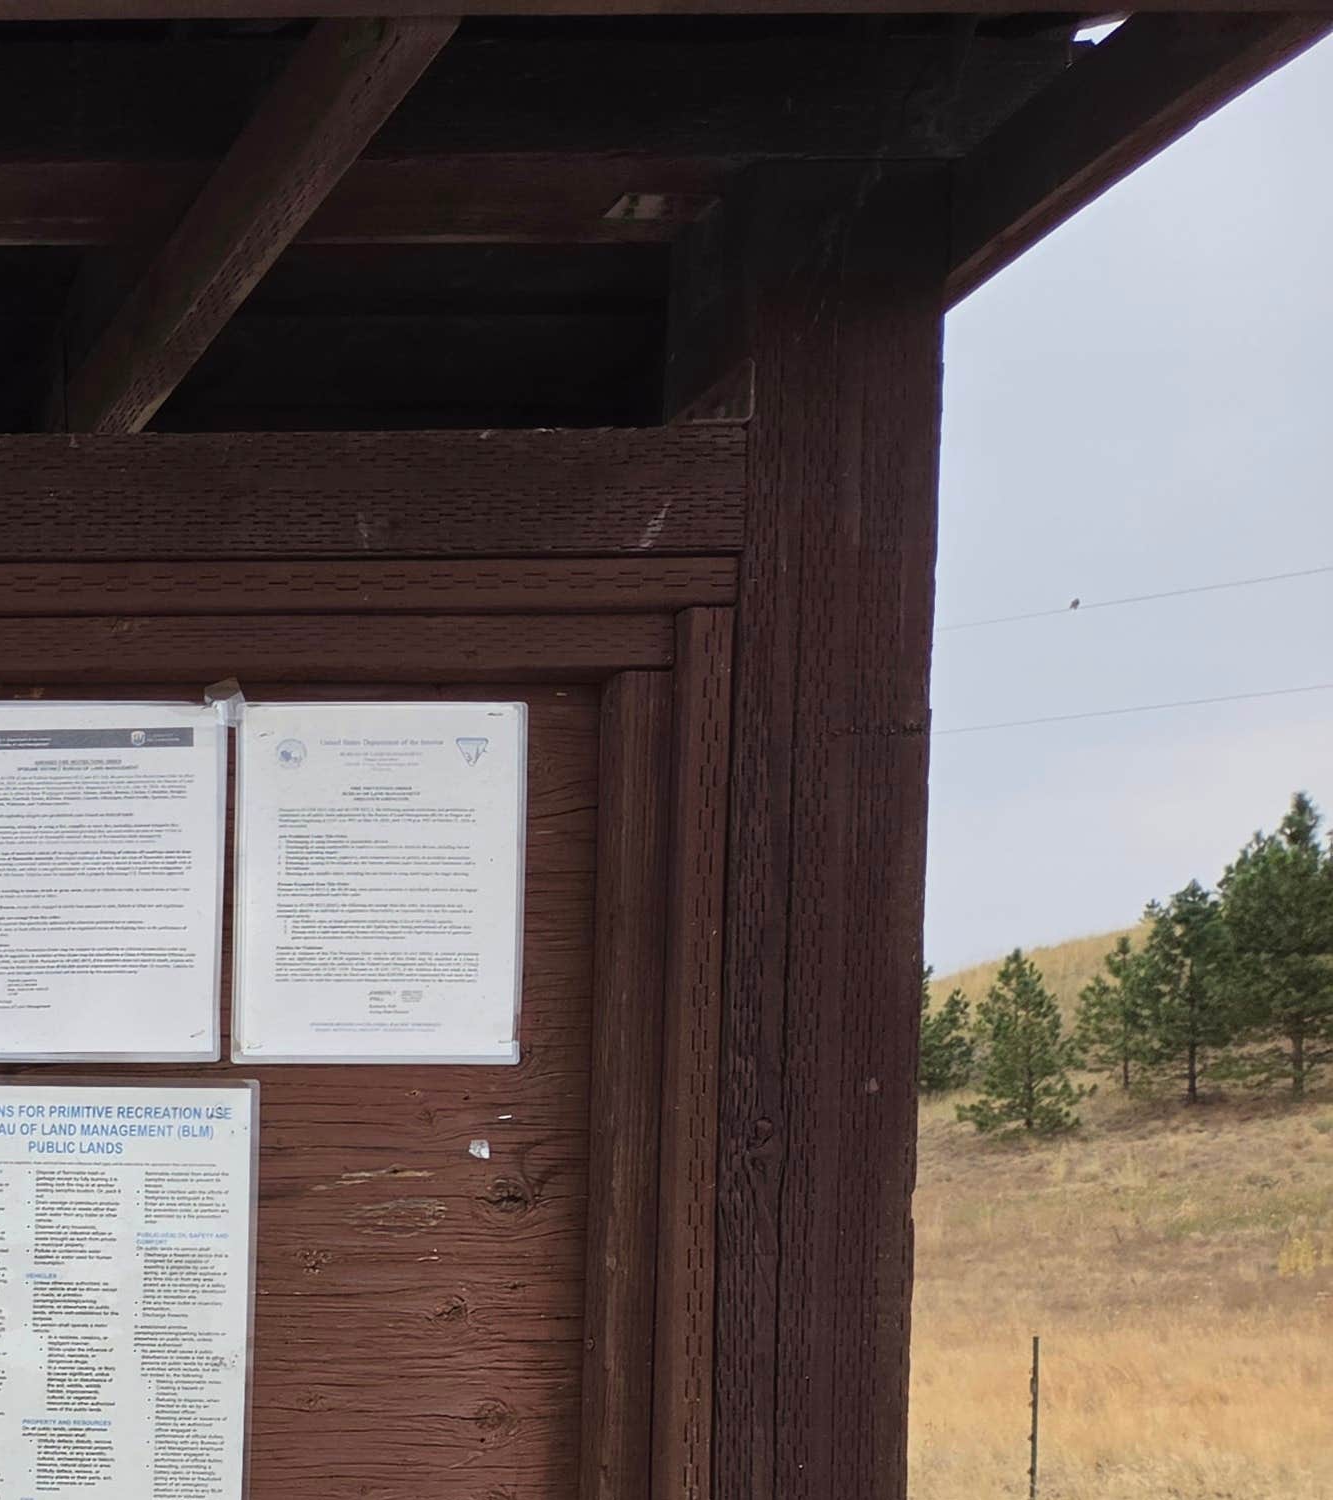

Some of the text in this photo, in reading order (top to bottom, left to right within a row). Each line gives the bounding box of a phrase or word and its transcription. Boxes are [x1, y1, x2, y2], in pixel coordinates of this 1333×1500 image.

[18, 1106, 45, 1118] FOR
[50, 1106, 112, 1118] PRIMITIVE
[117, 1107, 201, 1119] RECREATION
[205, 1107, 231, 1119] USE
[28, 1141, 123, 1154] PUBLIC LANDS
